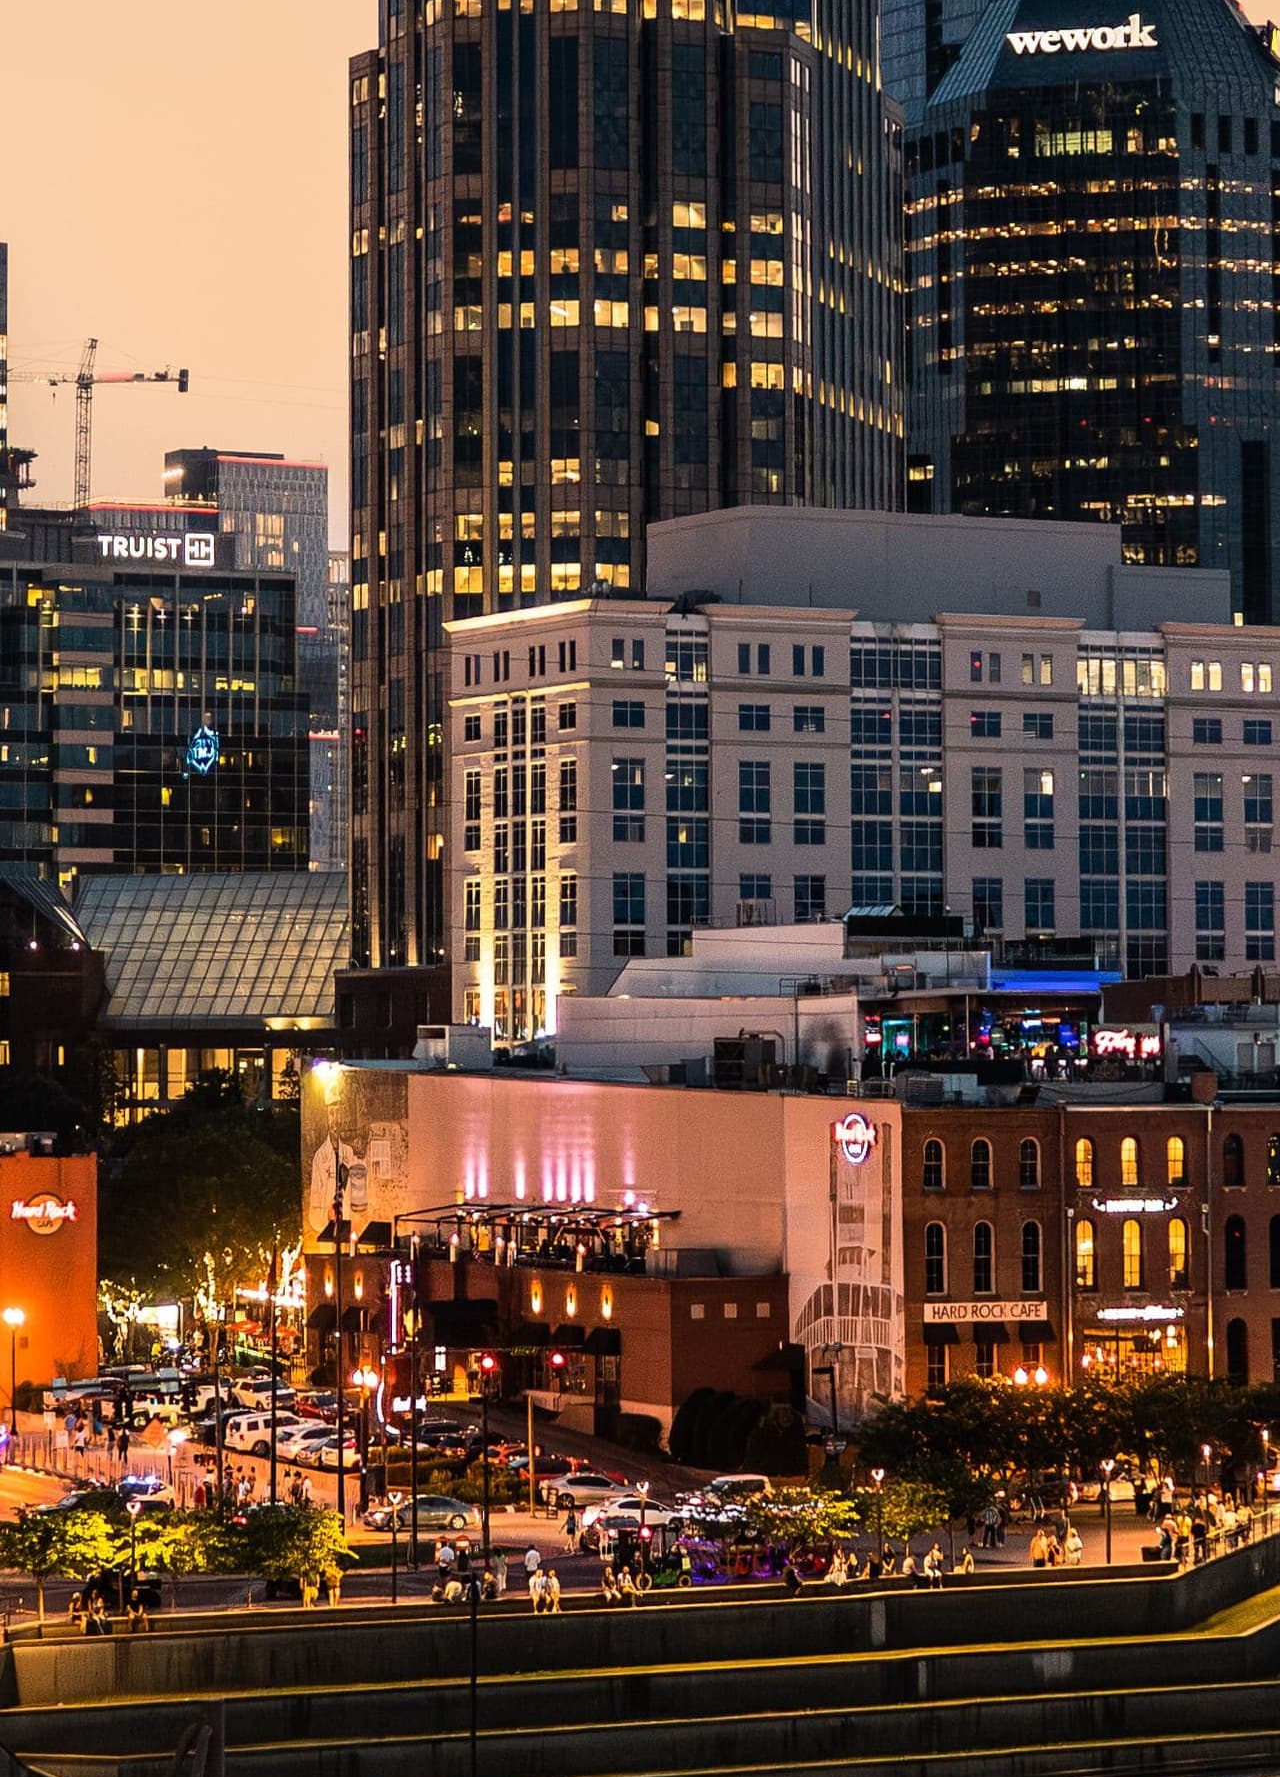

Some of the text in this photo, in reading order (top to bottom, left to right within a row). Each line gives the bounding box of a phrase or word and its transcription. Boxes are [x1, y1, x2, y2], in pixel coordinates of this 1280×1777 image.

[1006, 13, 1159, 54] wework
[97, 534, 181, 560] TRUIST
[932, 1303, 1042, 1320] HARD ROCK CAFE
